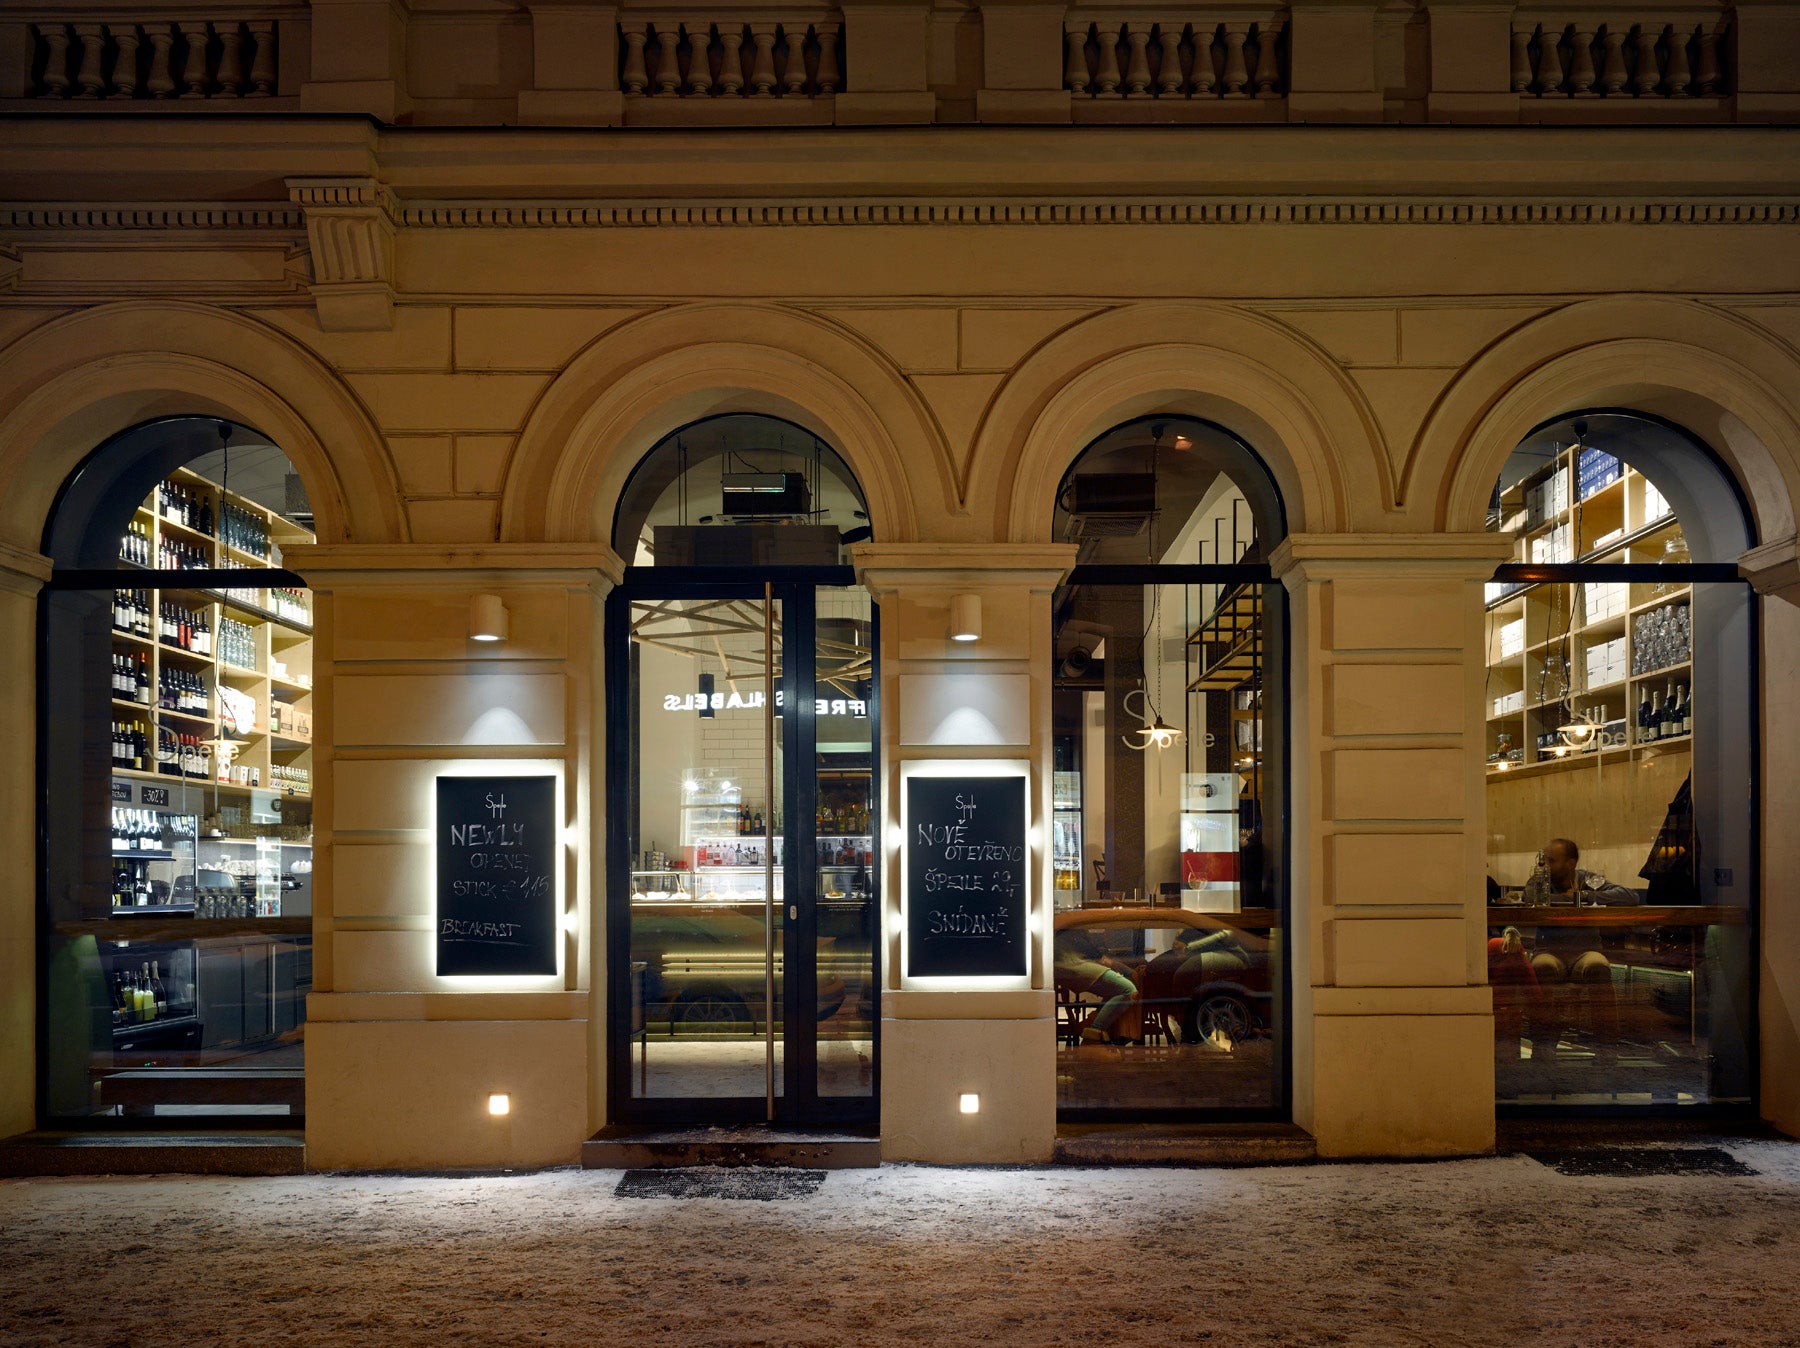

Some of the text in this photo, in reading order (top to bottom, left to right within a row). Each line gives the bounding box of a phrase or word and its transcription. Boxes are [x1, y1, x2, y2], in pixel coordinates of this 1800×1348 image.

[451, 823, 525, 846] NEWLY
[918, 819, 969, 846] NOVĚ
[453, 880, 497, 899] STICK
[440, 918, 522, 937] BREAKFAST
